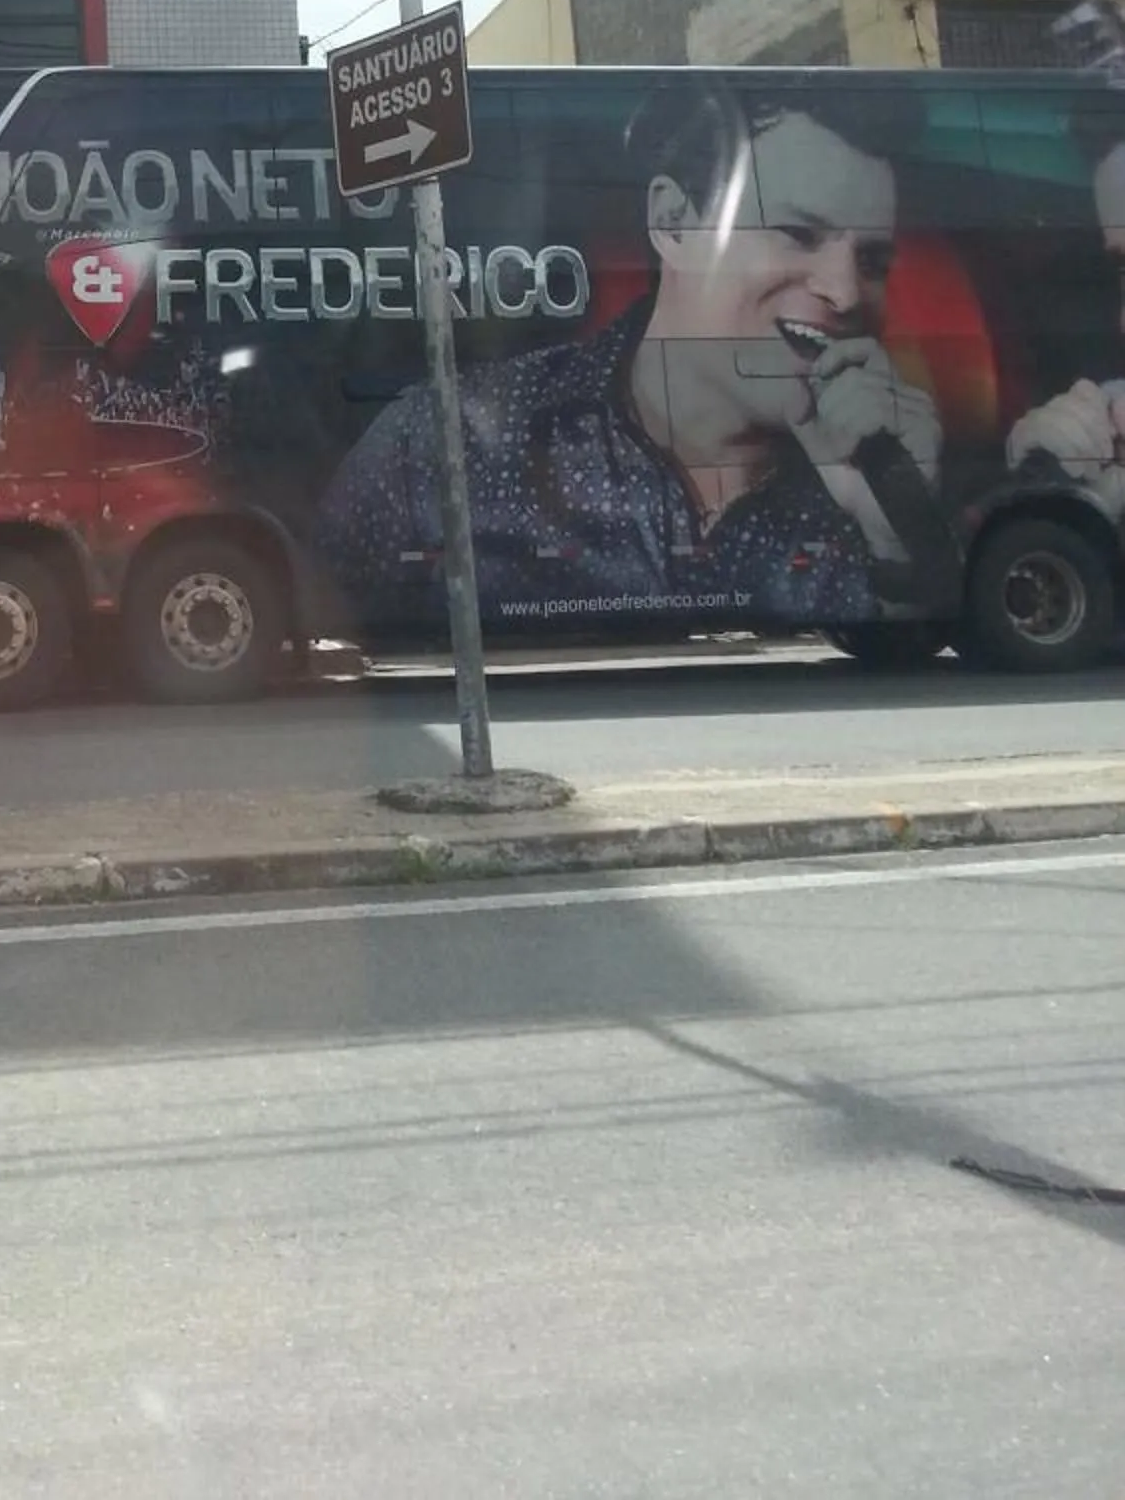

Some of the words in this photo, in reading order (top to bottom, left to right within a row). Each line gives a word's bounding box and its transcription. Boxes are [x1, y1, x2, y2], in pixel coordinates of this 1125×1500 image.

[338, 25, 458, 93] SANTUÁRIO
[350, 77, 432, 129] ACESSO
[440, 67, 454, 96] 3
[155, 245, 590, 325] FREDERICO
